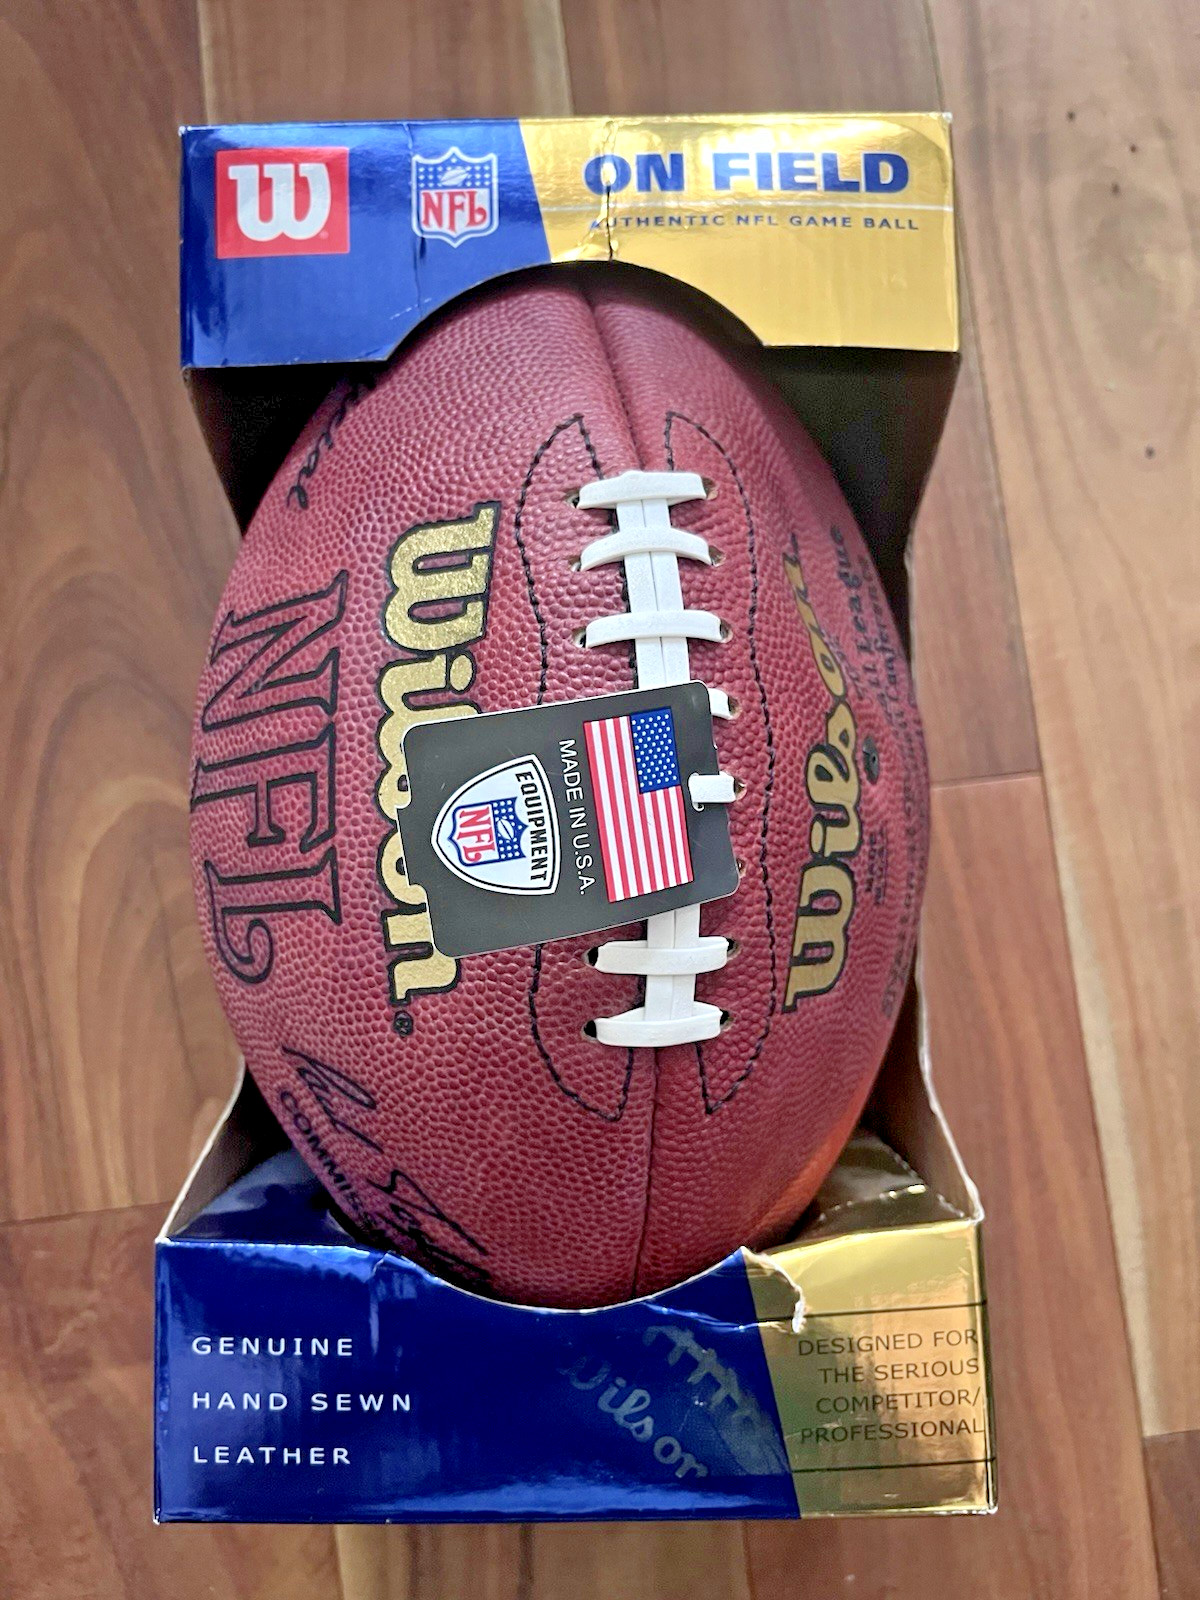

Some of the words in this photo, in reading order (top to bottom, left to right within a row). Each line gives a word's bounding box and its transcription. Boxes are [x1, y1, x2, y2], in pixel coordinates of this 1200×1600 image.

[583, 152, 686, 195] ON
[711, 151, 909, 194] FIELD
[419, 189, 488, 233] NFL
[736, 214, 779, 227] NFL
[789, 215, 853, 228] GAME
[864, 216, 919, 230] BALL
[189, 569, 349, 985] NFL
[558, 738, 582, 802] MADE
[514, 770, 549, 883] EQUIPMENT
[569, 806, 587, 828] IN
[458, 806, 497, 864] NFL
[572, 834, 596, 896] U.S.A.
[191, 1336, 353, 1356] GENUINE
[797, 1333, 923, 1356] DESIGNED
[933, 1328, 979, 1348] FOR
[818, 1364, 865, 1384] THE
[874, 1357, 979, 1381] SERIOUS
[192, 1391, 289, 1411] HAND
[310, 1393, 411, 1412] SEWN
[815, 1386, 982, 1415] COMPETITOR/
[800, 1418, 985, 1444] PROFESSIONAL
[193, 1445, 351, 1465] LEATHER
